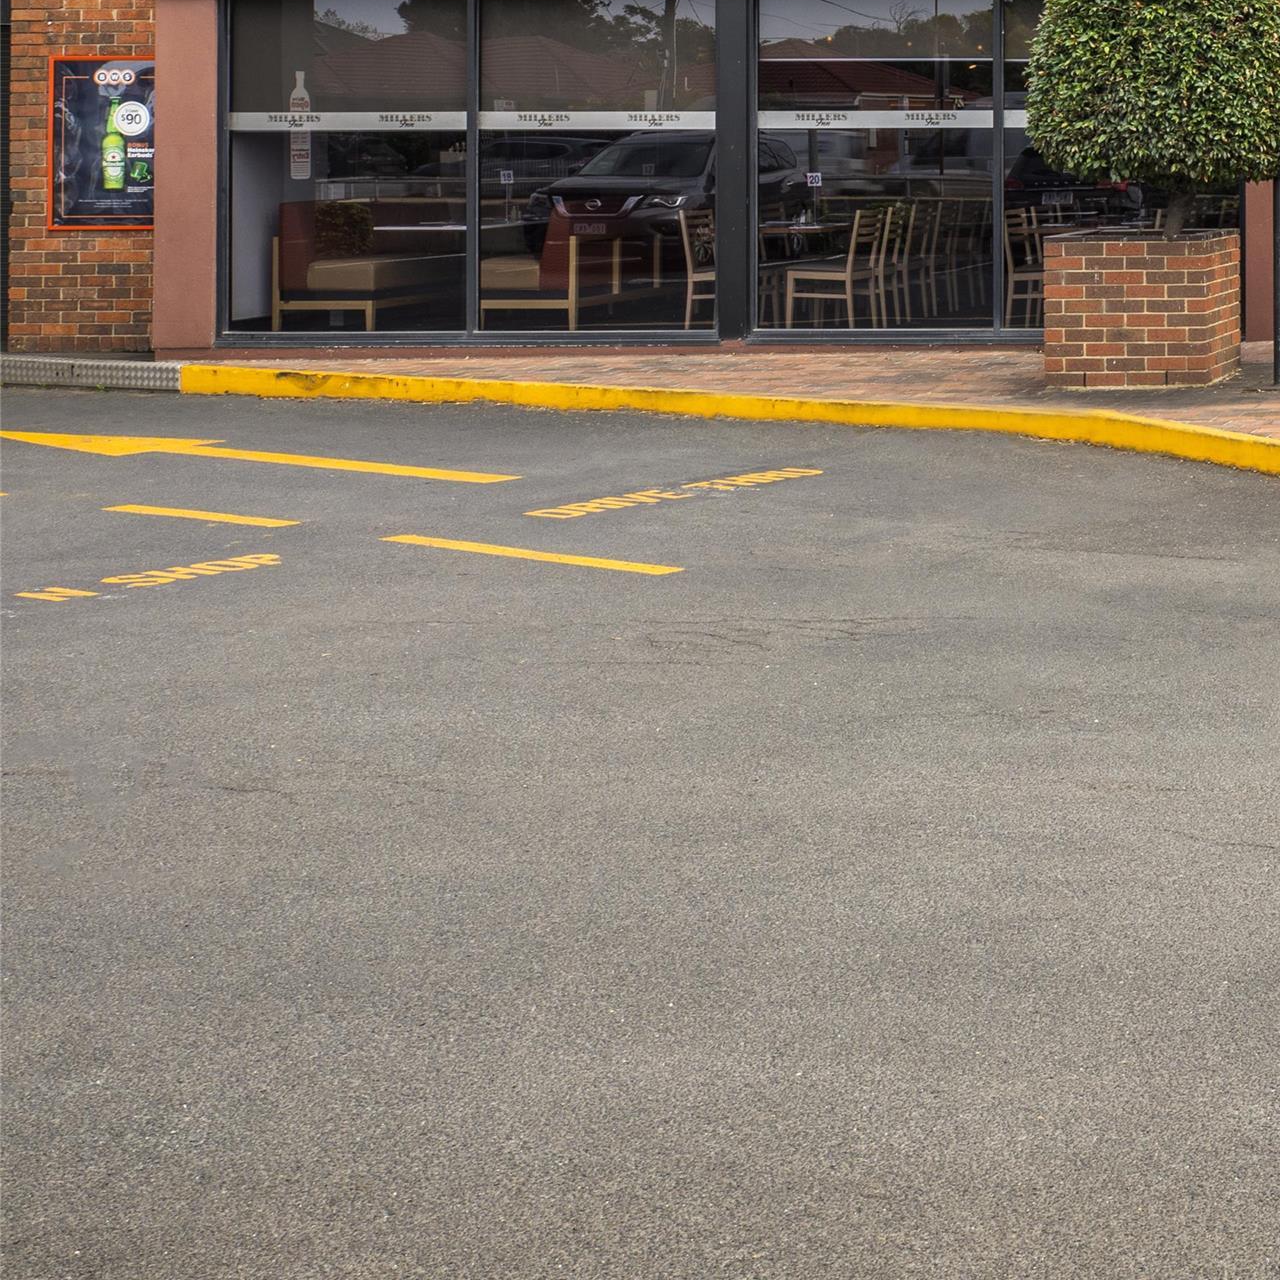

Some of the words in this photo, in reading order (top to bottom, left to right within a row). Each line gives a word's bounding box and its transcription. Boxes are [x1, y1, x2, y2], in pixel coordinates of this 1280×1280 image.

[267, 113, 322, 122] MILLERS
[378, 113, 433, 122] MILLERS
[517, 113, 571, 122] MILLERS
[627, 113, 681, 122] MILLERS
[795, 112, 848, 121] MILLERS
[904, 112, 958, 121] MILLERS
[288, 119, 305, 128] Inn
[399, 119, 415, 128] Inn
[537, 119, 554, 128] Inn
[648, 119, 663, 128] Inn
[815, 118, 831, 127] Inn
[924, 118, 941, 127] Inn
[502, 172, 512, 182] 18
[809, 175, 820, 185] 20
[522, 489, 697, 519] DRIVE
[681, 467, 824, 491] THRU
[100, 553, 281, 587] SHOP
